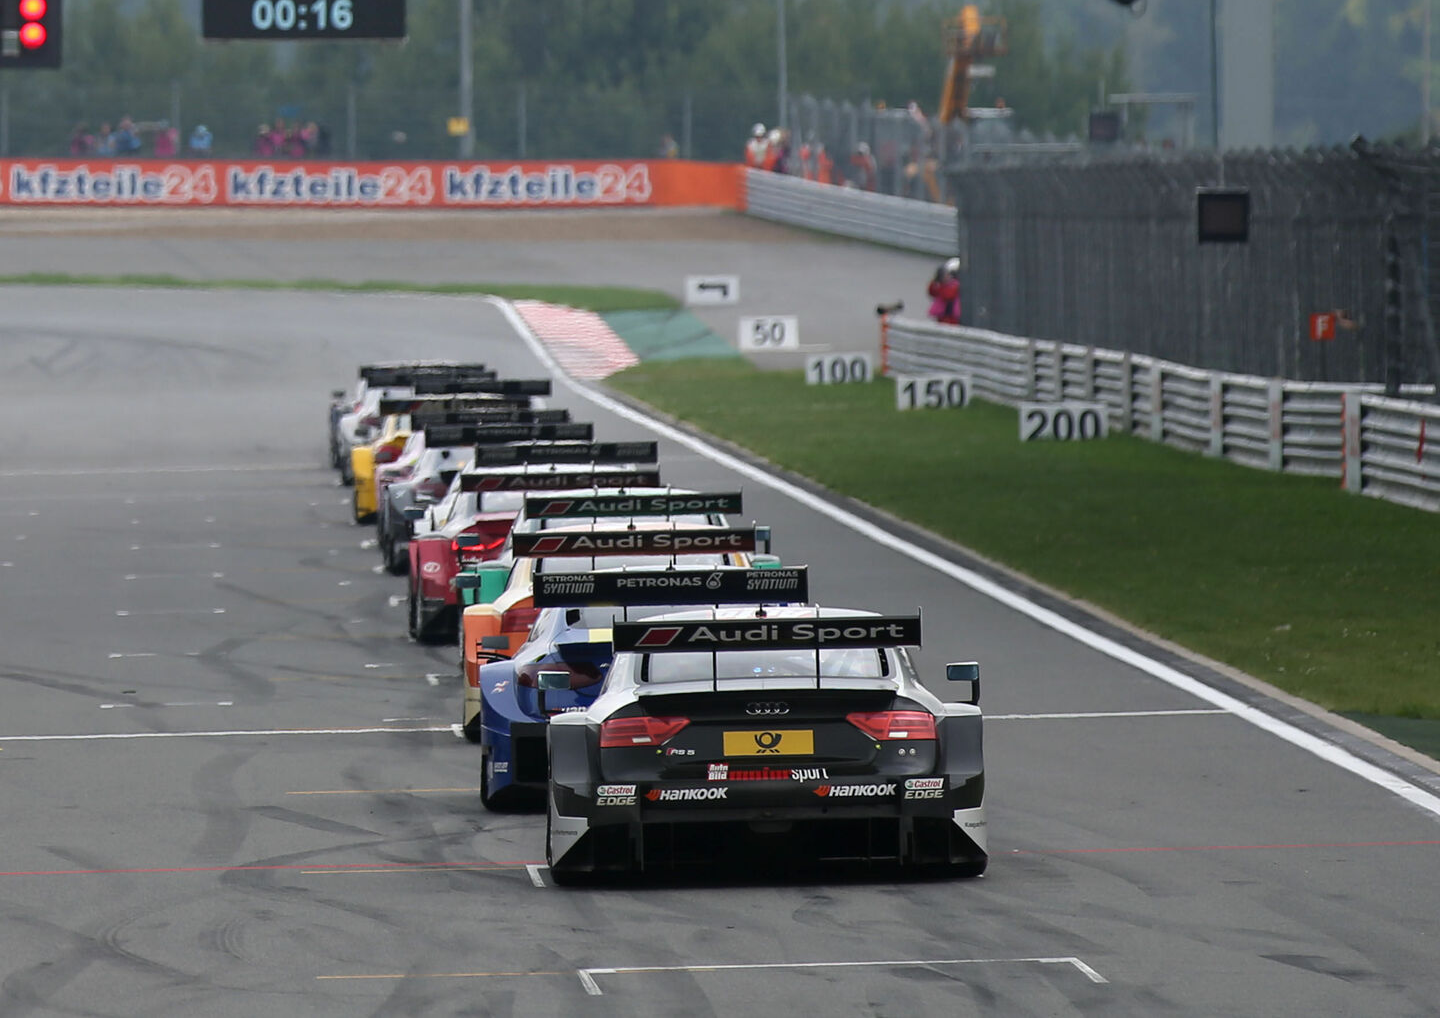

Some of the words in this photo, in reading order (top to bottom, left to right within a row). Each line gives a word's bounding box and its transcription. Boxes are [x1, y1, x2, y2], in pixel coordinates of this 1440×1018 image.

[10, 162, 217, 203] kfzteile24
[227, 164, 434, 204] kfzteile24
[443, 164, 652, 203] kfzteile24
[754, 320, 785, 344] 50
[812, 358, 867, 383] 100
[903, 380, 966, 409] 150
[1026, 410, 1102, 441] 200
[578, 499, 641, 511] Audi
[651, 498, 728, 512] Sport
[571, 535, 643, 549] Audi
[653, 533, 742, 551] Sport
[542, 574, 595, 582] PETRONAS
[617, 576, 702, 587] PETRONAS
[688, 625, 779, 642] Audi
[792, 623, 905, 642] Sport
[606, 786, 634, 795] Castrol
[914, 780, 941, 788] Castrol
[597, 796, 636, 805] EDGE
[904, 789, 944, 799] EDGE
